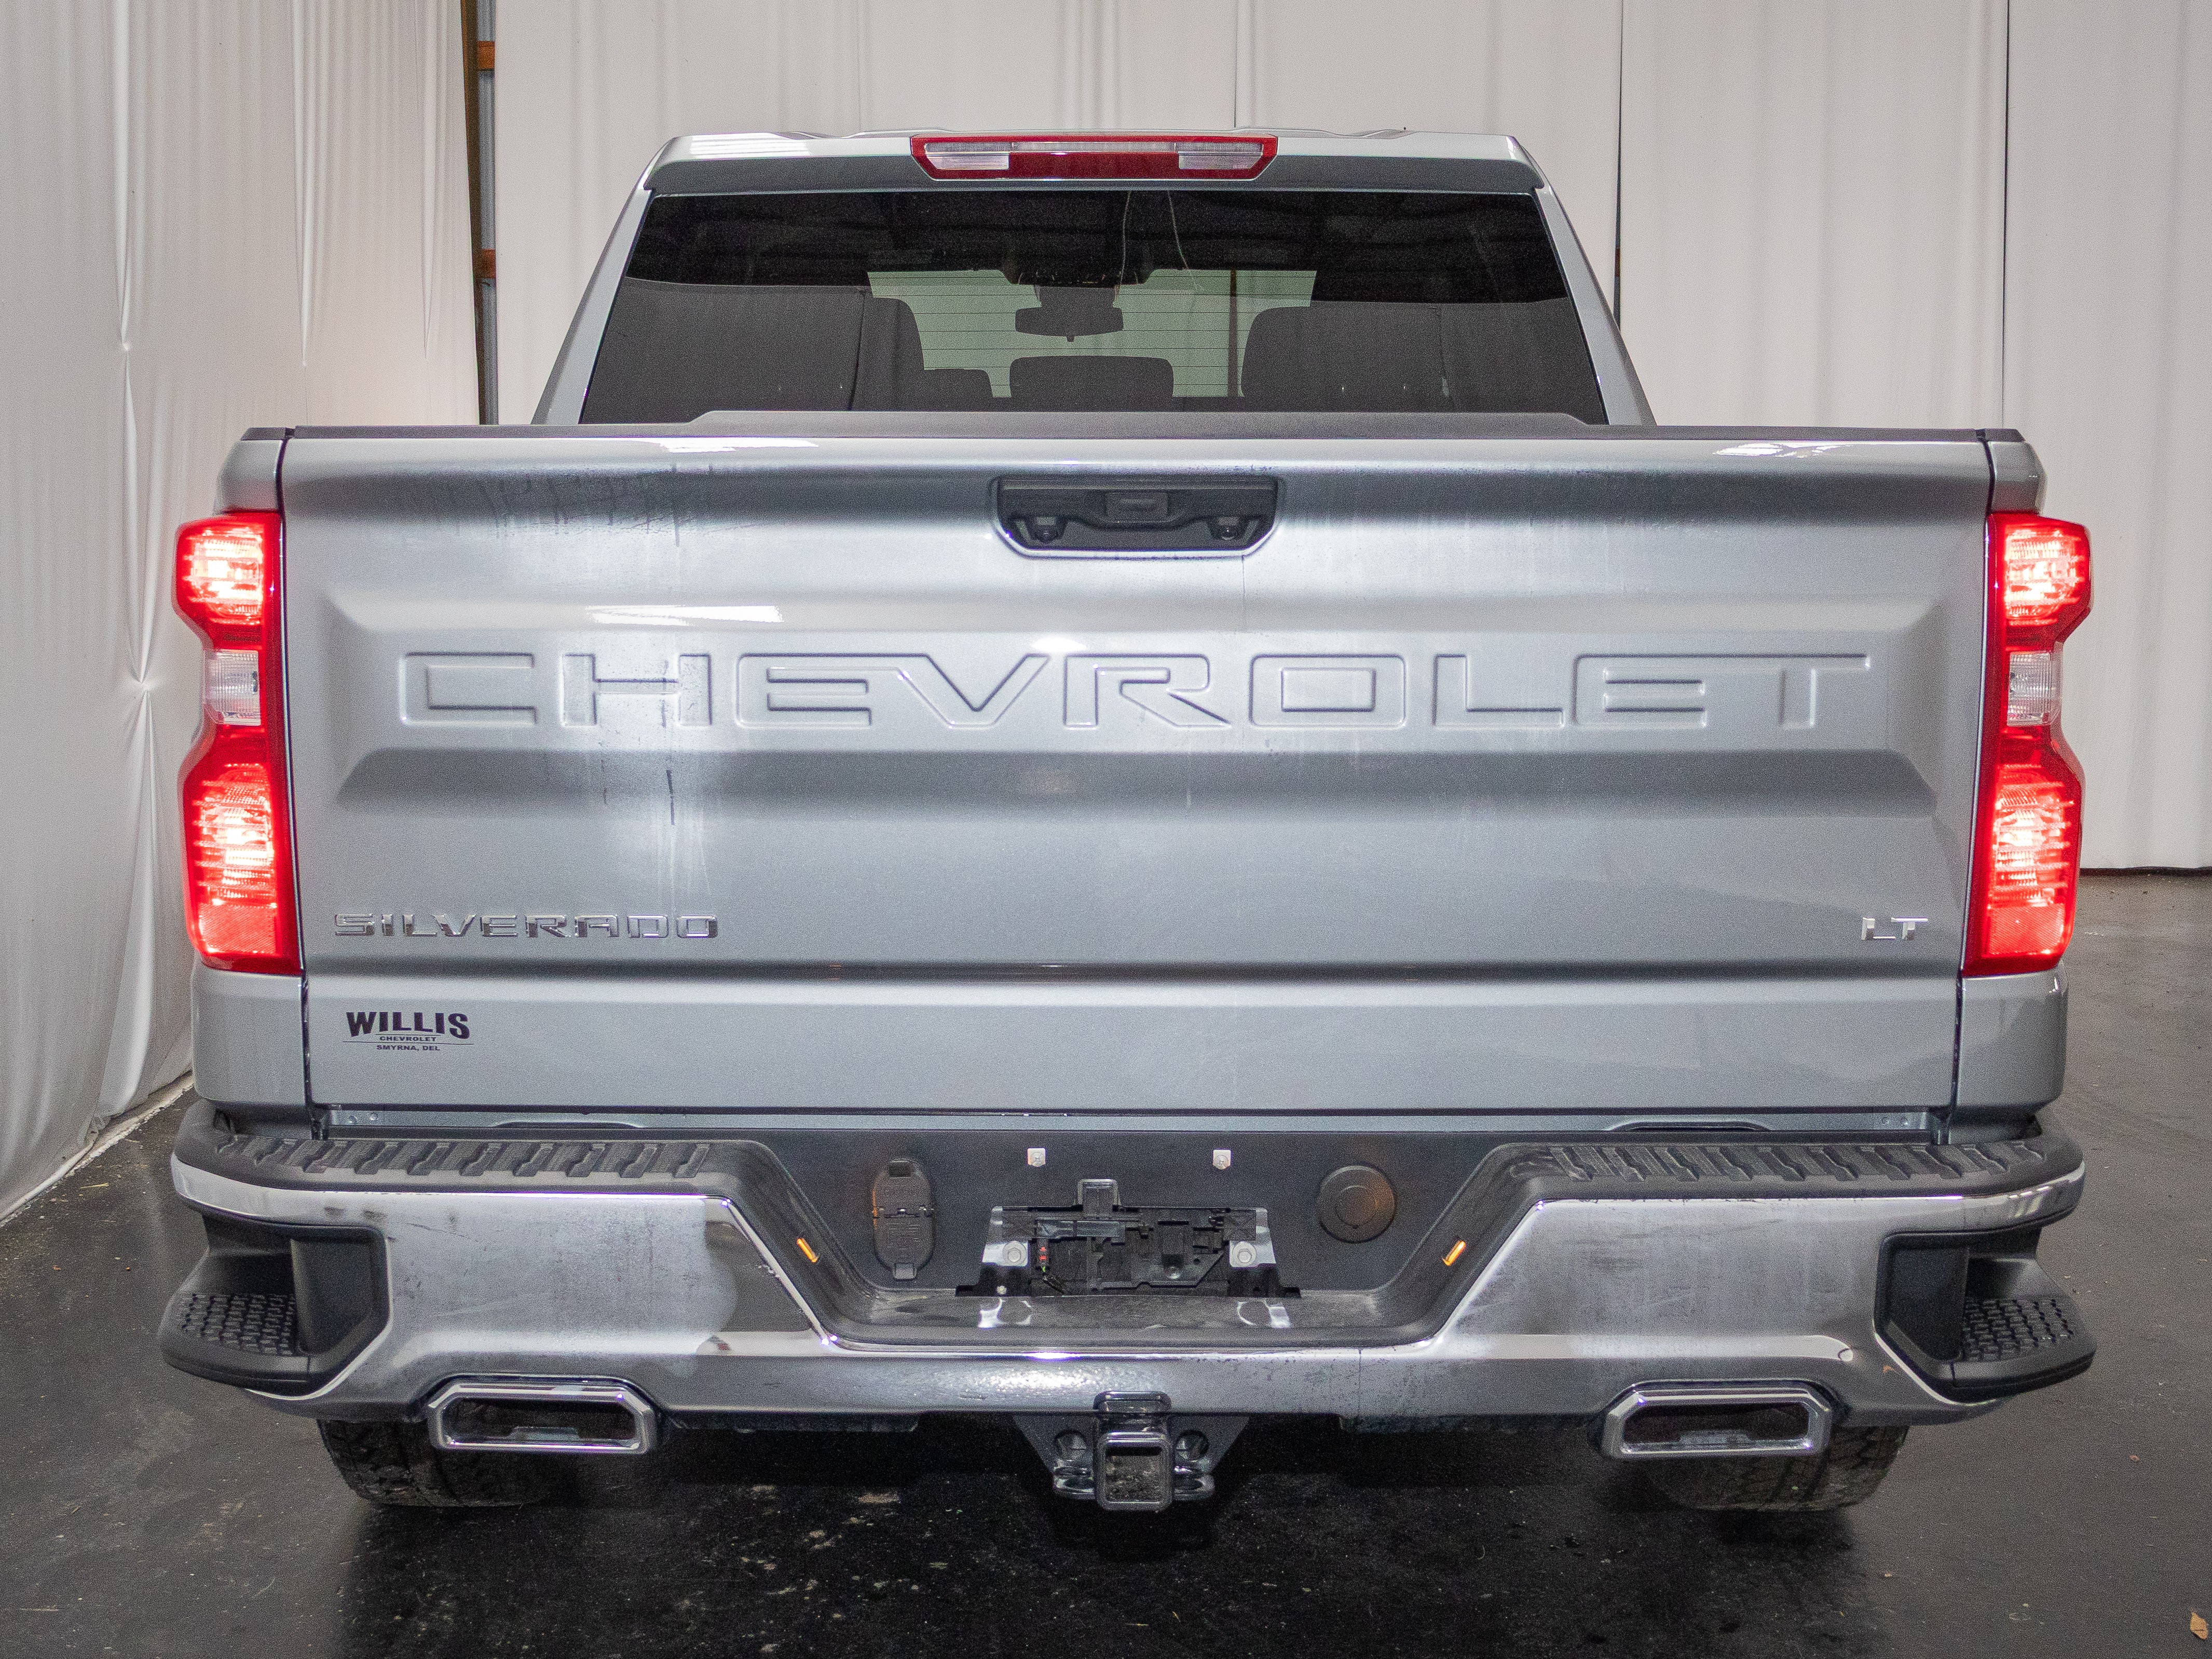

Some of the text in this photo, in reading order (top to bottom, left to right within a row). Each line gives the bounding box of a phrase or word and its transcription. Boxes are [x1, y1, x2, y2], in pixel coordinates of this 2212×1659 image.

[397, 652, 1871, 731] CHEVROLET
[334, 913, 719, 939] SILVERADO
[1861, 917, 1929, 941] LT
[346, 1012, 470, 1039] WILLIS
